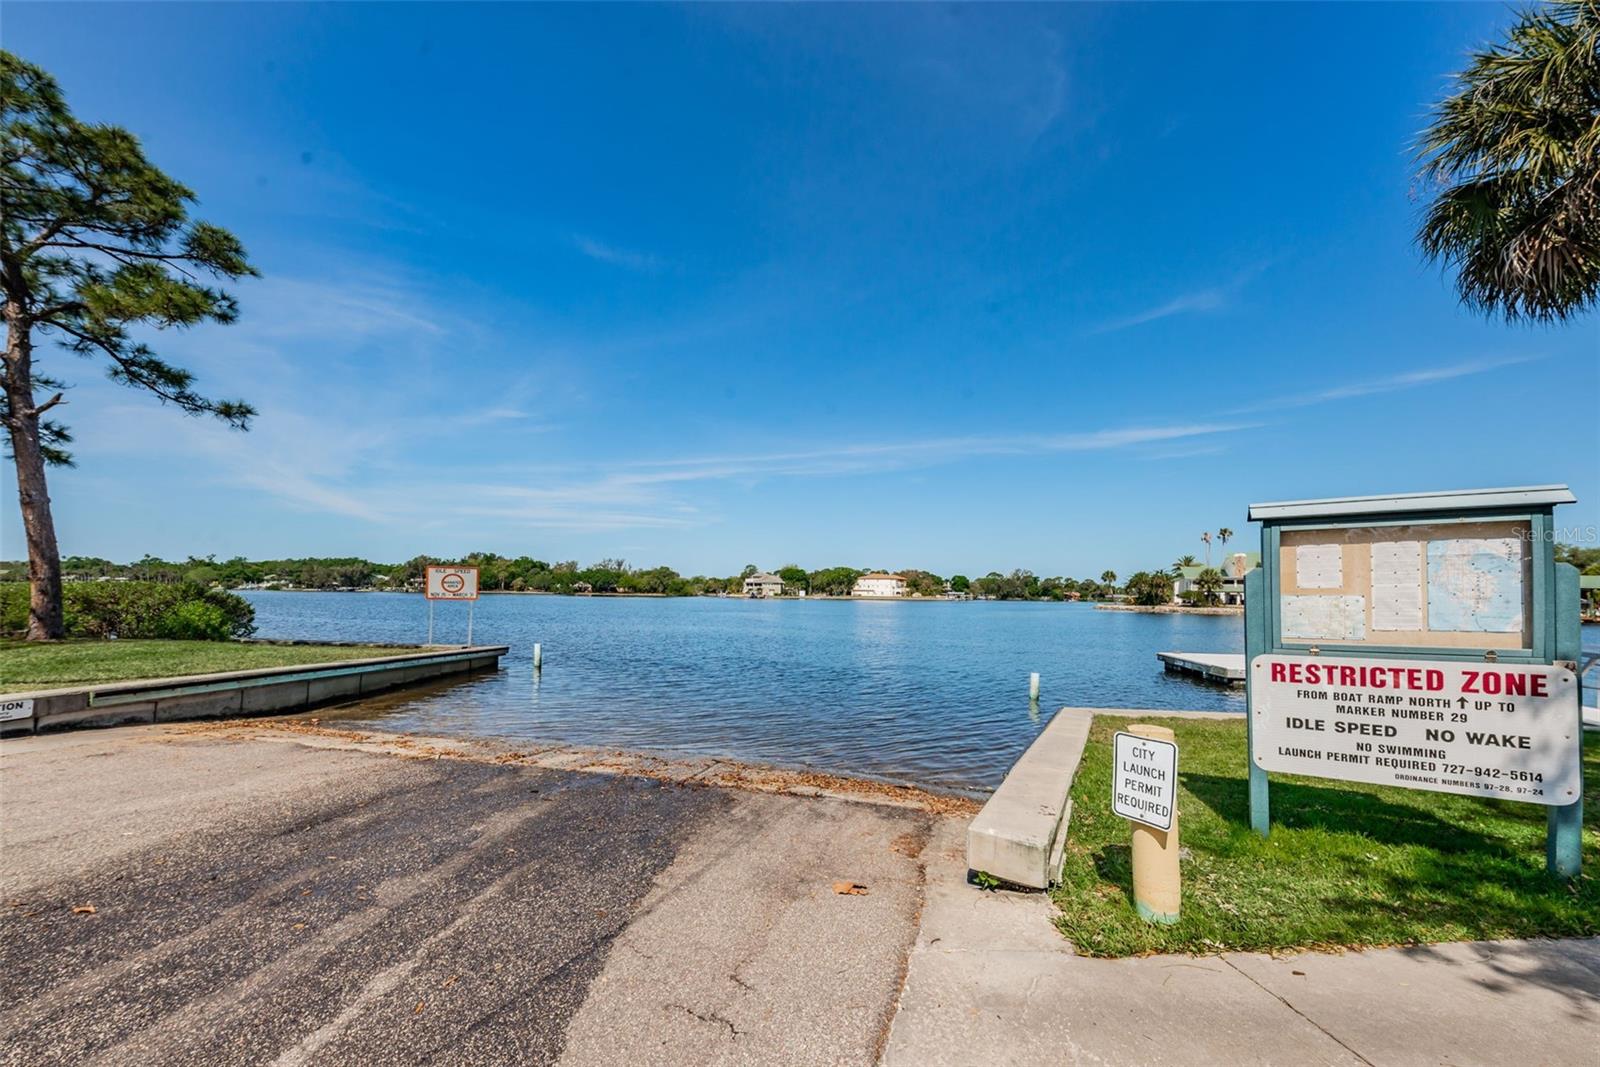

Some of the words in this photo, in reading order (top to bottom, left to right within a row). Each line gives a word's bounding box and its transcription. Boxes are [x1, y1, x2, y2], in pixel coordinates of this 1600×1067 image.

[1271, 663, 1444, 691] RESTRICTED
[1461, 670, 1549, 698] ZONE
[0, 702, 24, 711] ION
[1297, 689, 1328, 701] FROM
[1333, 691, 1364, 703] BOAT
[1368, 694, 1404, 706] RAMP
[1409, 696, 1451, 709] NORTH
[1475, 701, 1492, 711] UP
[1499, 702, 1515, 713] TO
[1336, 705, 1386, 718] MARKER
[1391, 708, 1445, 722] NUMBER
[1451, 712, 1468, 724] 29
[1286, 717, 1326, 732] IDLE
[1334, 721, 1398, 738] SPEED
[1426, 728, 1456, 743] NO
[1466, 731, 1532, 750] WAKE
[1132, 746, 1155, 760] CITY
[1356, 742, 1373, 753] NO
[1378, 744, 1447, 760] SWIMMING
[1123, 761, 1165, 781] LAUNCH
[1278, 746, 1321, 759] LAUNCH
[1326, 751, 1371, 765] PERMIT
[1375, 757, 1437, 772] REQUIRED
[1442, 763, 1544, 784] 727-942-5614
[1124, 778, 1163, 797] PERMIT
[1394, 773, 1438, 785] ORDINANCE
[1441, 778, 1481, 789] NUMBERS
[1516, 786, 1544, 796] 97-24
[1117, 792, 1169, 817] REQUIRED
